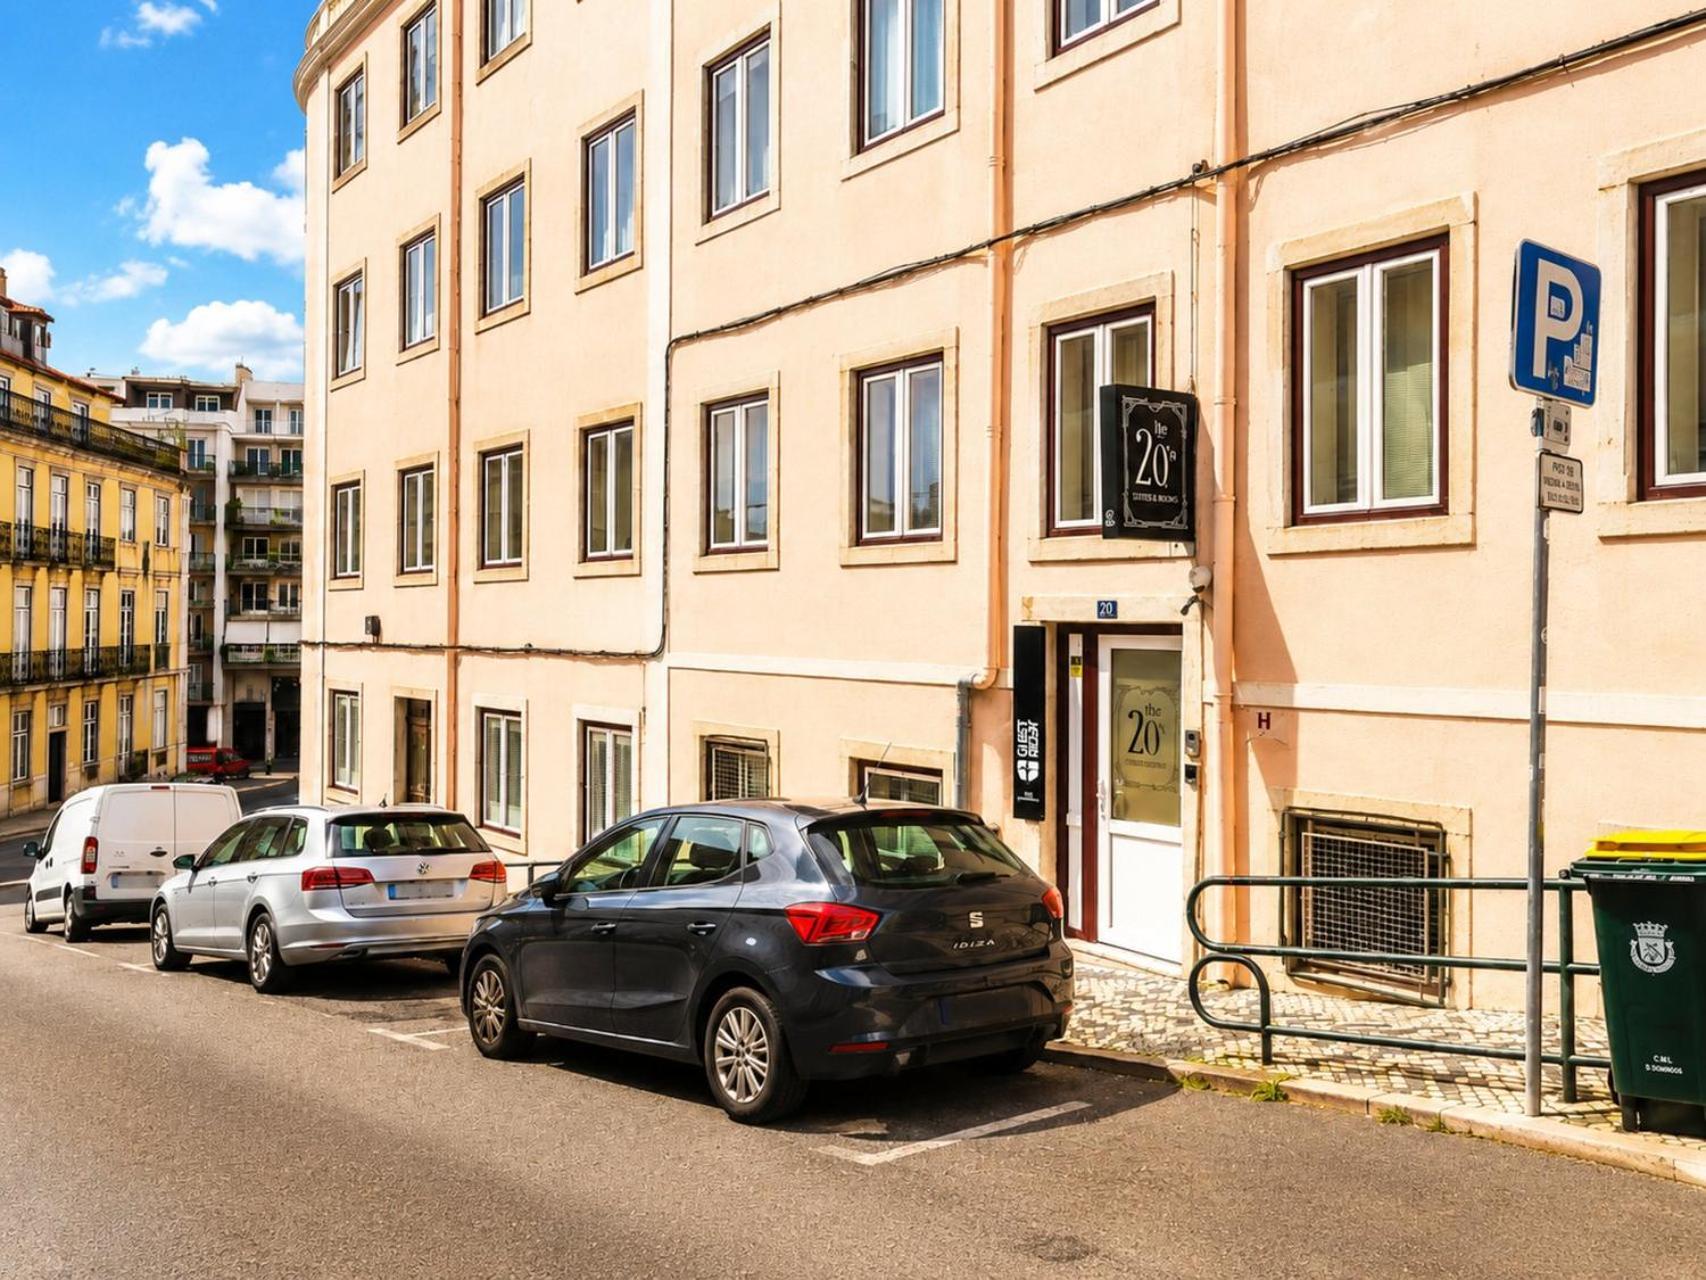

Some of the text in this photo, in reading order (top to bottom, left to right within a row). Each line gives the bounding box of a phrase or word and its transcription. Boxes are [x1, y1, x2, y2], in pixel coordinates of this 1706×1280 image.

[1532, 257, 1584, 380] P
[1099, 601, 1113, 615] 20
[1145, 703, 1161, 717] the
[1257, 711, 1271, 730] H
